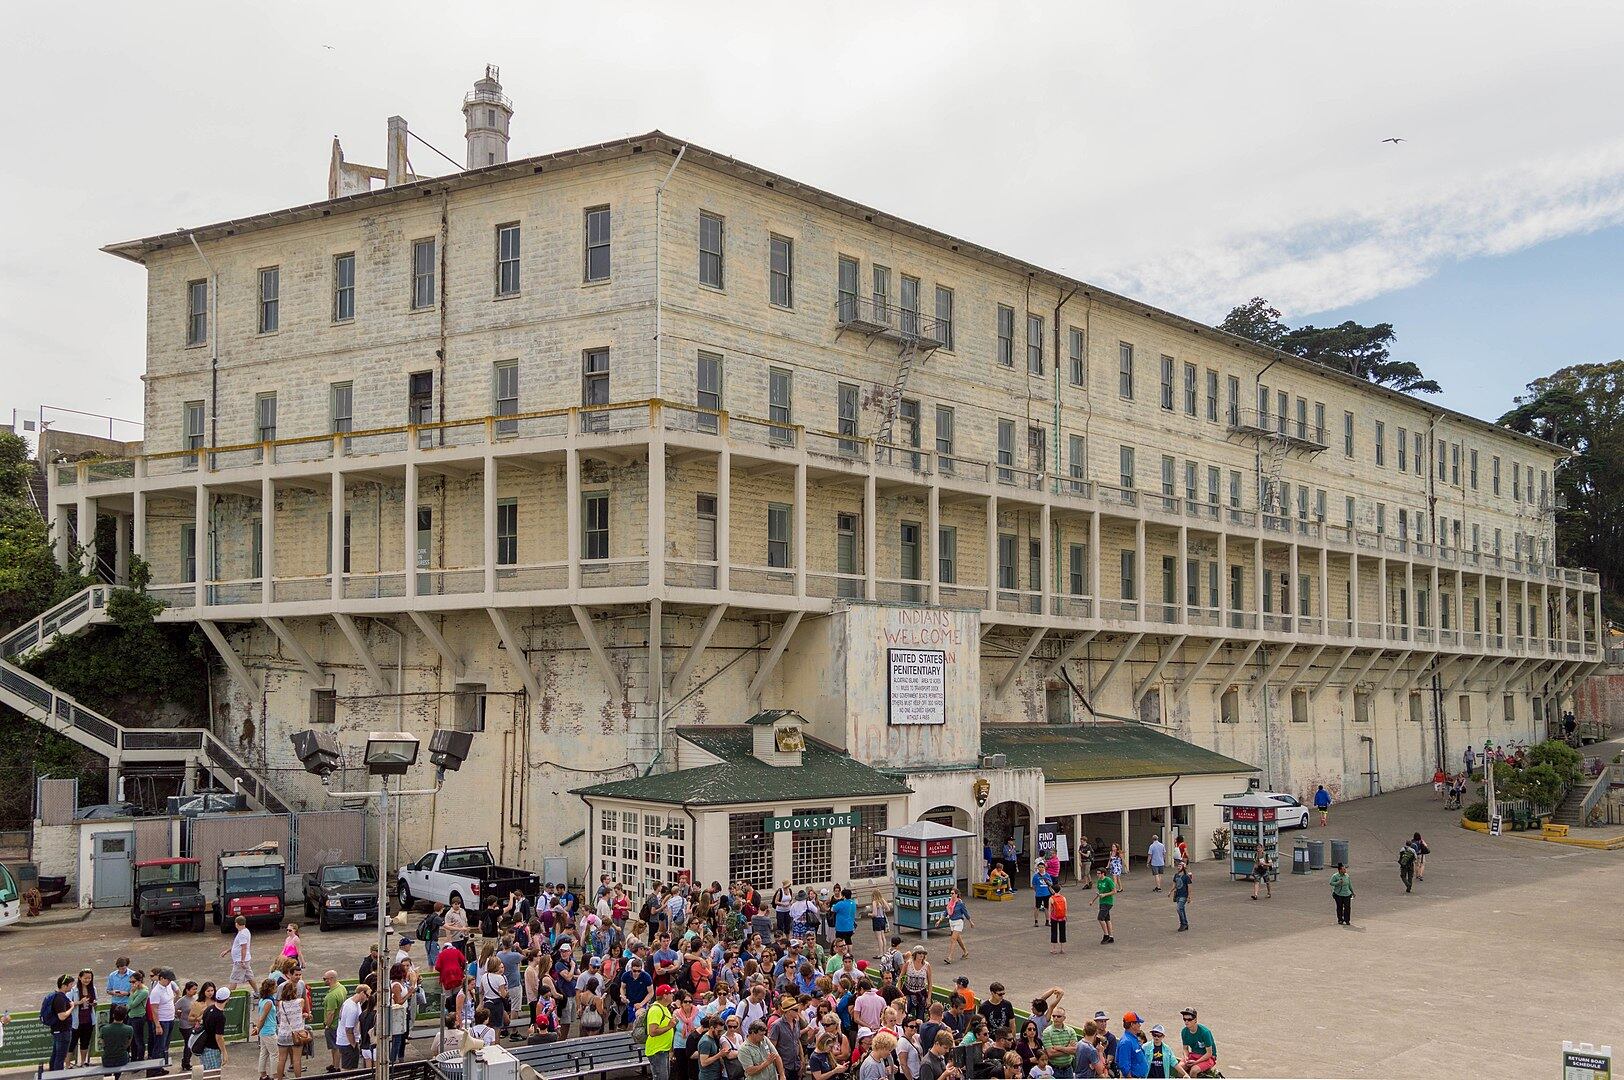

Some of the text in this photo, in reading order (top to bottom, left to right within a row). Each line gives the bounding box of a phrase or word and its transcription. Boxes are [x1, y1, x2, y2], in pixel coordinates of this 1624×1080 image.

[898, 609, 950, 628] INDIANS
[883, 627, 962, 645] WELCOME
[891, 653, 943, 664] UNITED STATES
[893, 664, 941, 676] PENITENTIARY
[774, 815, 852, 830] BOOKSTORE
[1038, 832, 1054, 841] FIND
[1038, 840, 1056, 850] YOUR
[1572, 1061, 1601, 1069] SCHEDULE
